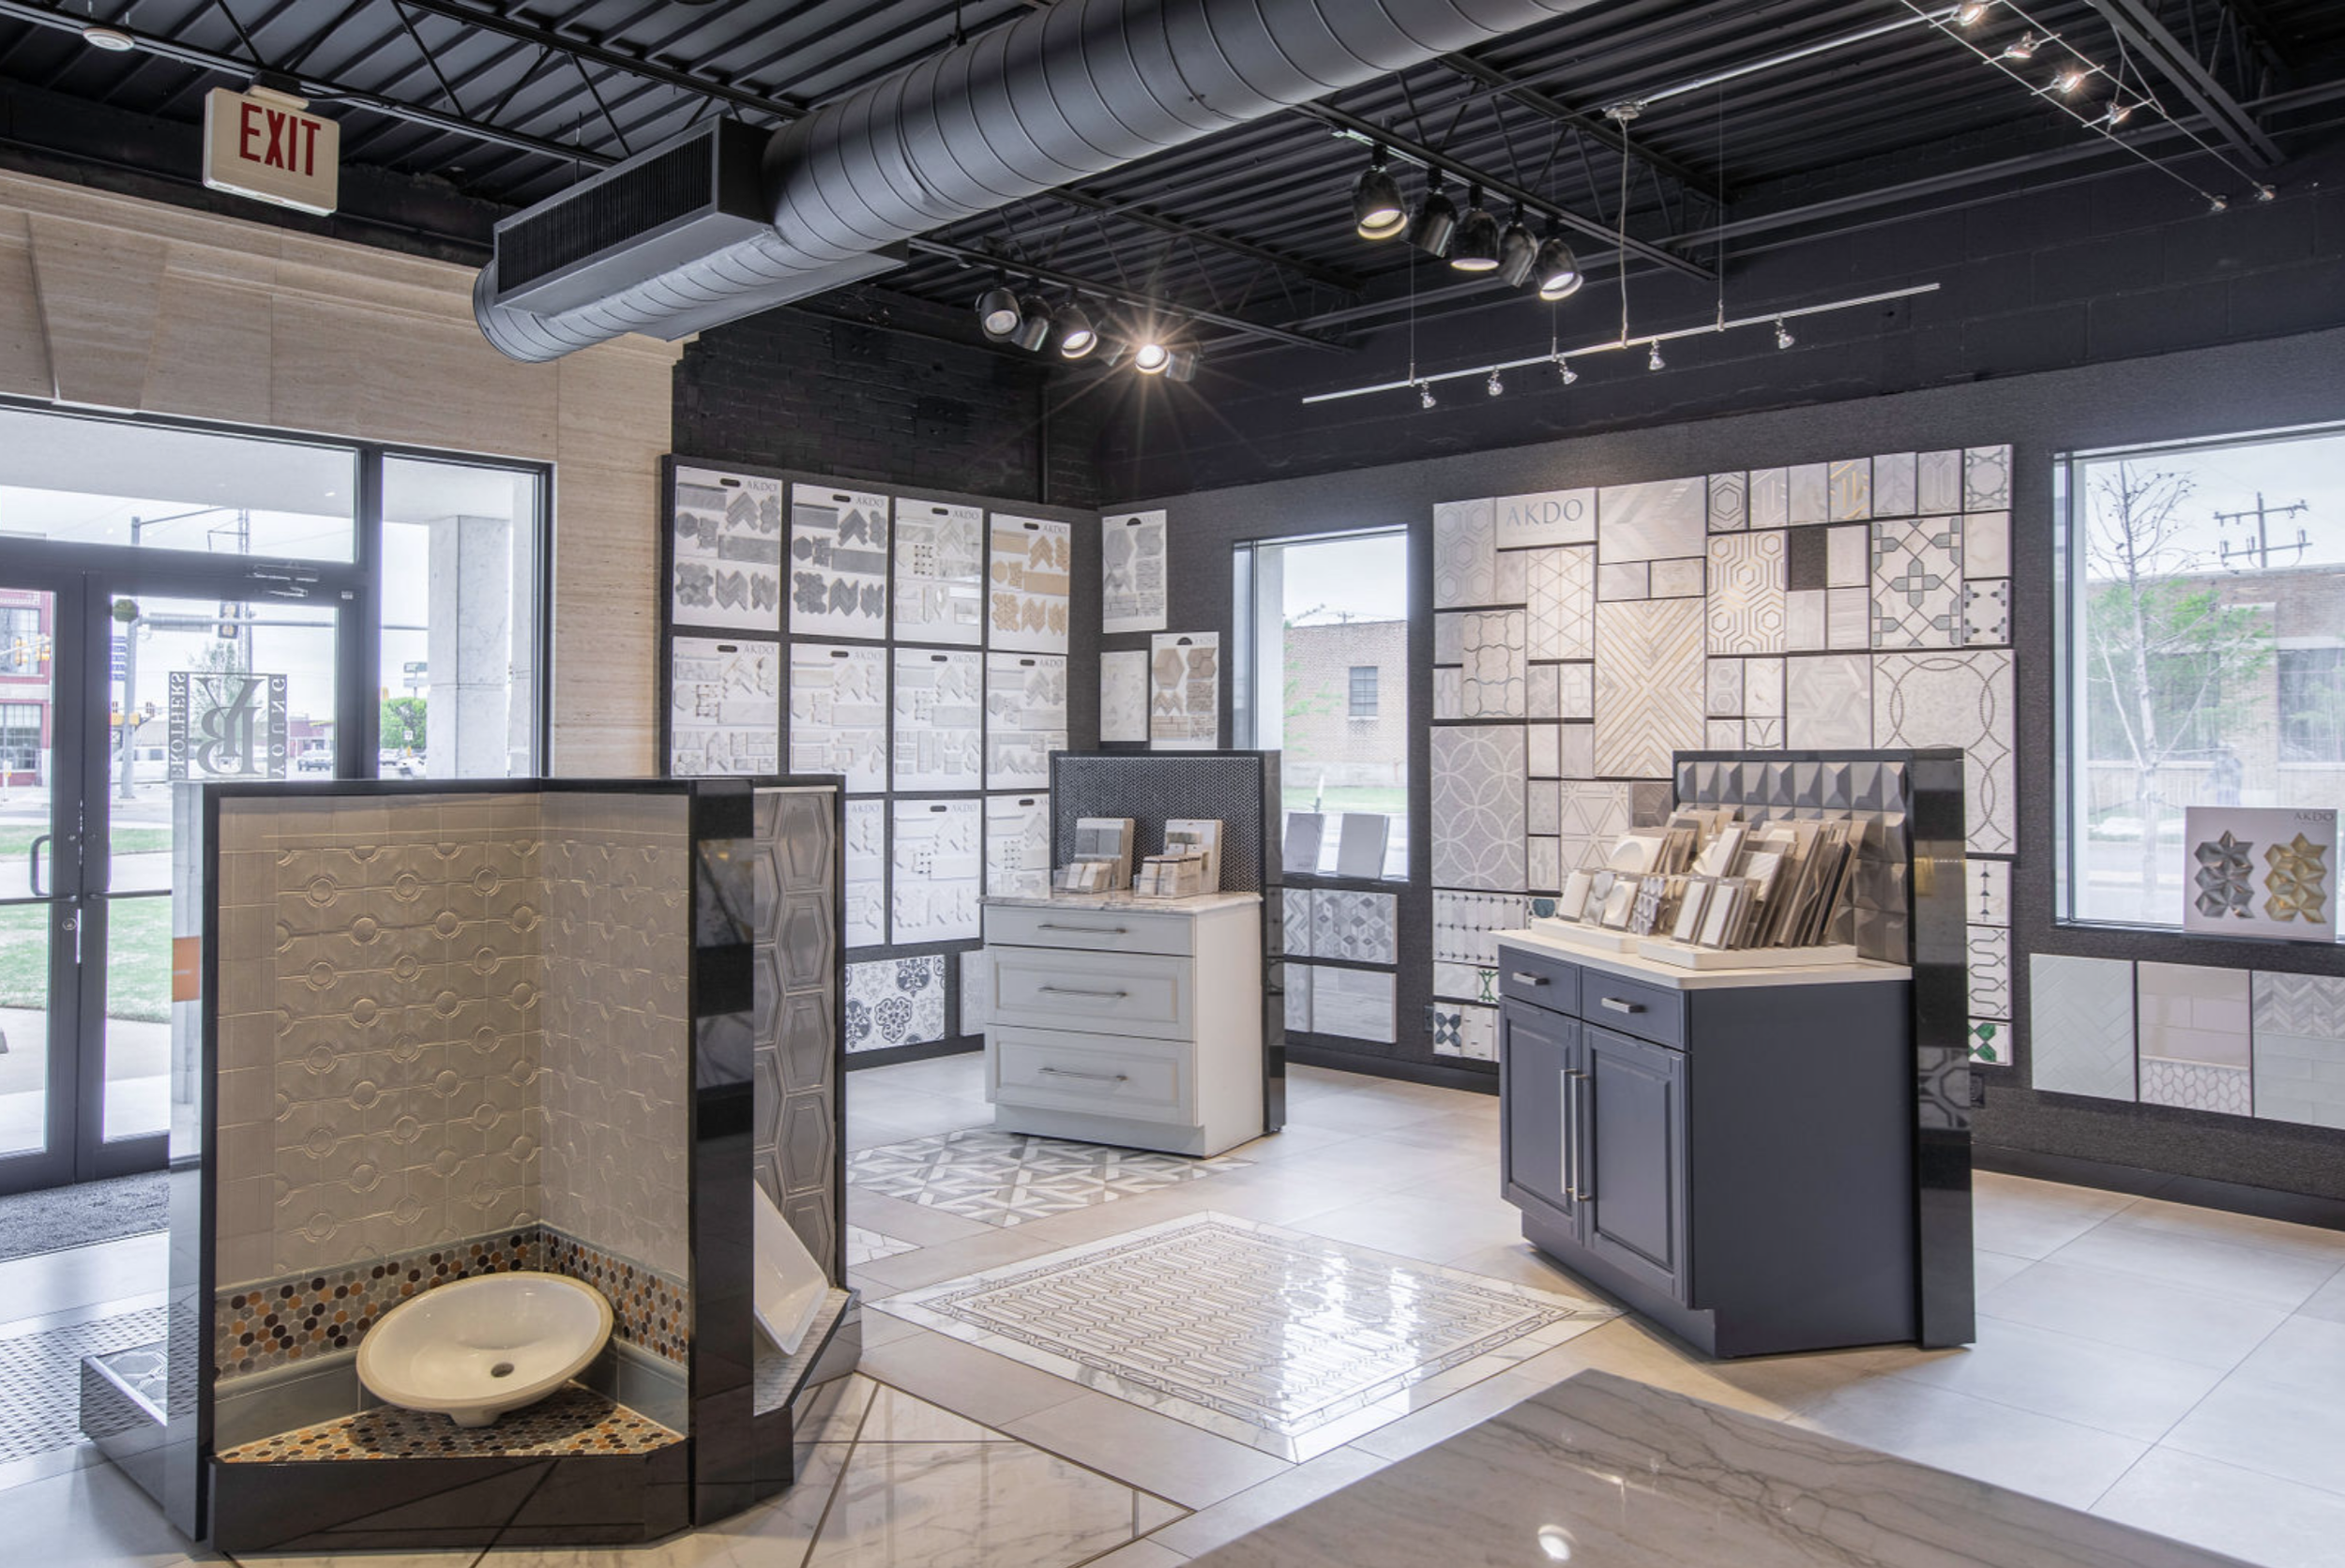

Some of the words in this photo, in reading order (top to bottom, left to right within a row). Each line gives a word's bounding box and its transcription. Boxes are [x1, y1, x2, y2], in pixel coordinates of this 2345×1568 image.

[239, 101, 322, 177] EXIT
[747, 479, 779, 492] AKDO
[855, 495, 885, 508] AKDO
[952, 509, 980, 520] AKDO
[1505, 498, 1583, 527] AKDO
[1042, 523, 1068, 535] AKDO
[743, 643, 776, 656] AKDO
[850, 804, 880, 815] AKDO
[950, 804, 977, 814] AKDO
[2294, 811, 2334, 822] AKDO
